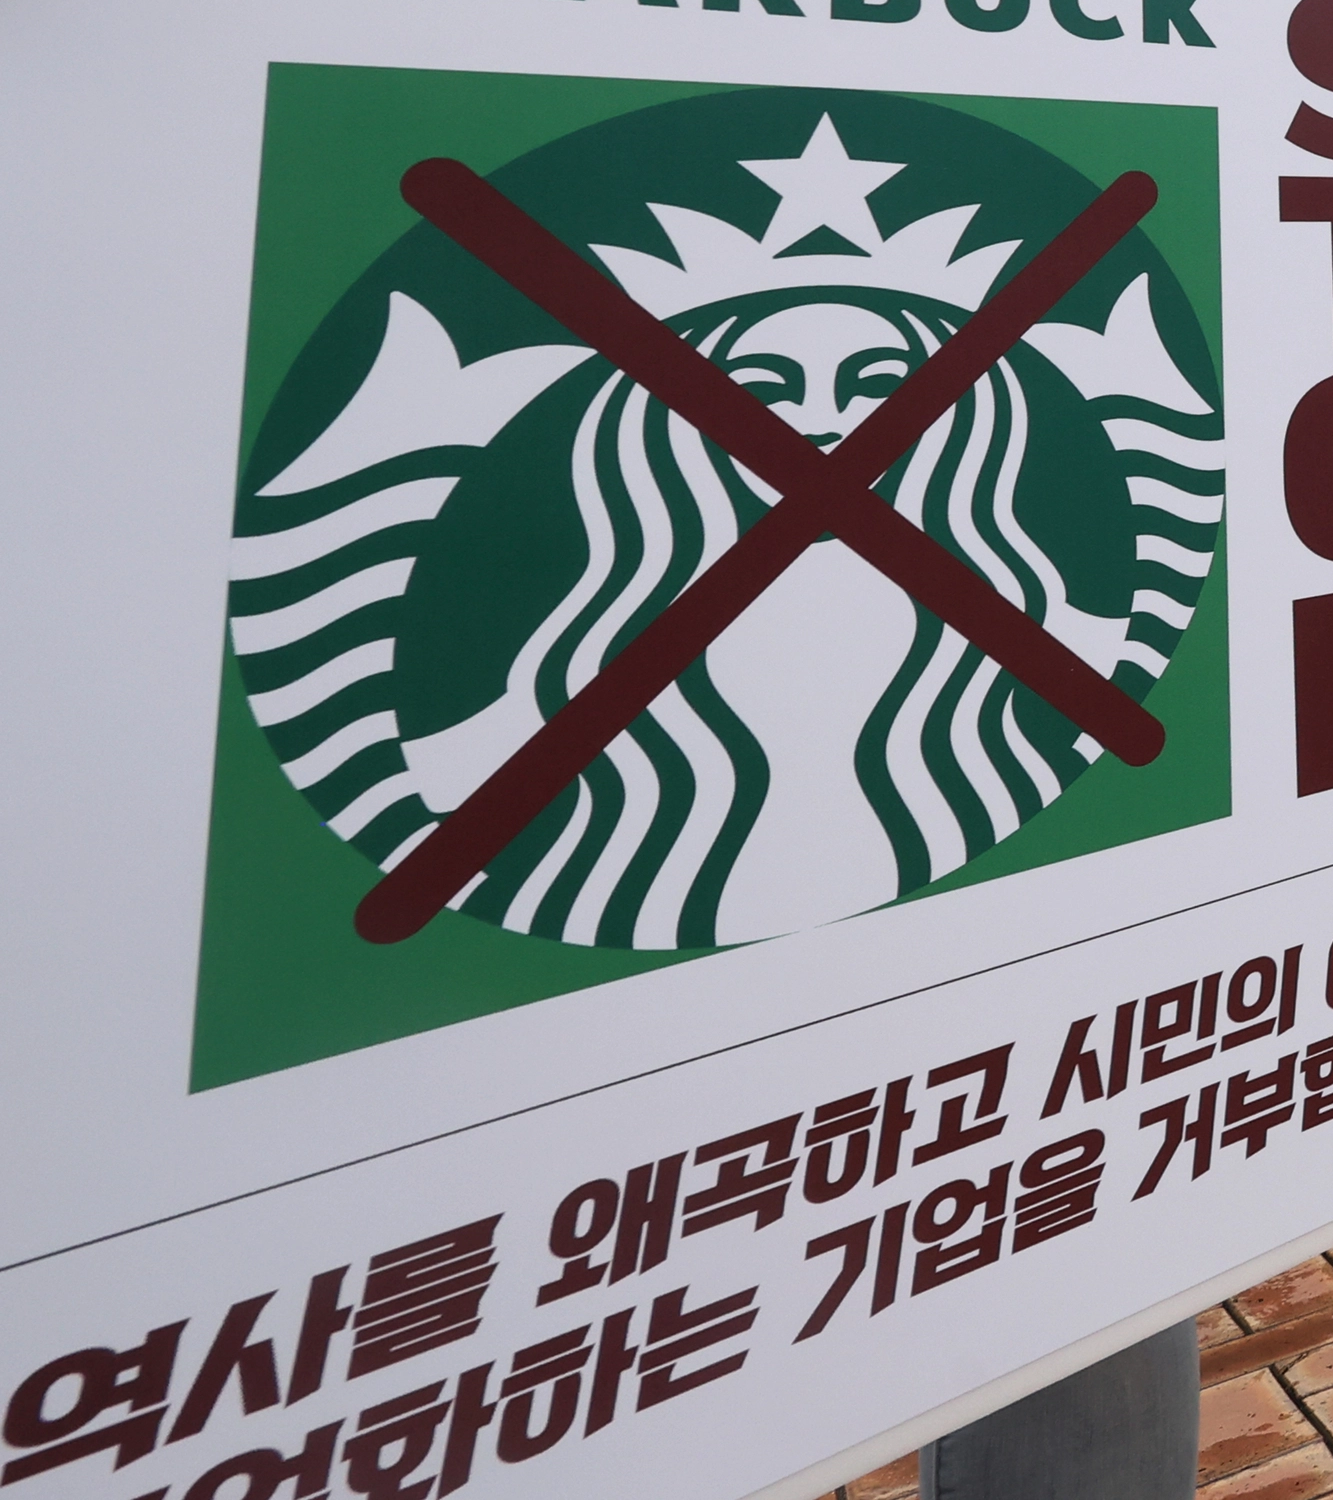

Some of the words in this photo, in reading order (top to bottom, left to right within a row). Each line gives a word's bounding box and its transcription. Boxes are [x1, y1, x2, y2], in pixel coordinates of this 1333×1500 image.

[0, 1211, 506, 1488] 역사를
[536, 1040, 1019, 1308] 왜곡하고
[1039, 966, 1299, 1123] 시민의
[130, 1284, 761, 1500] 화하는
[791, 1127, 1107, 1346] 기업을
